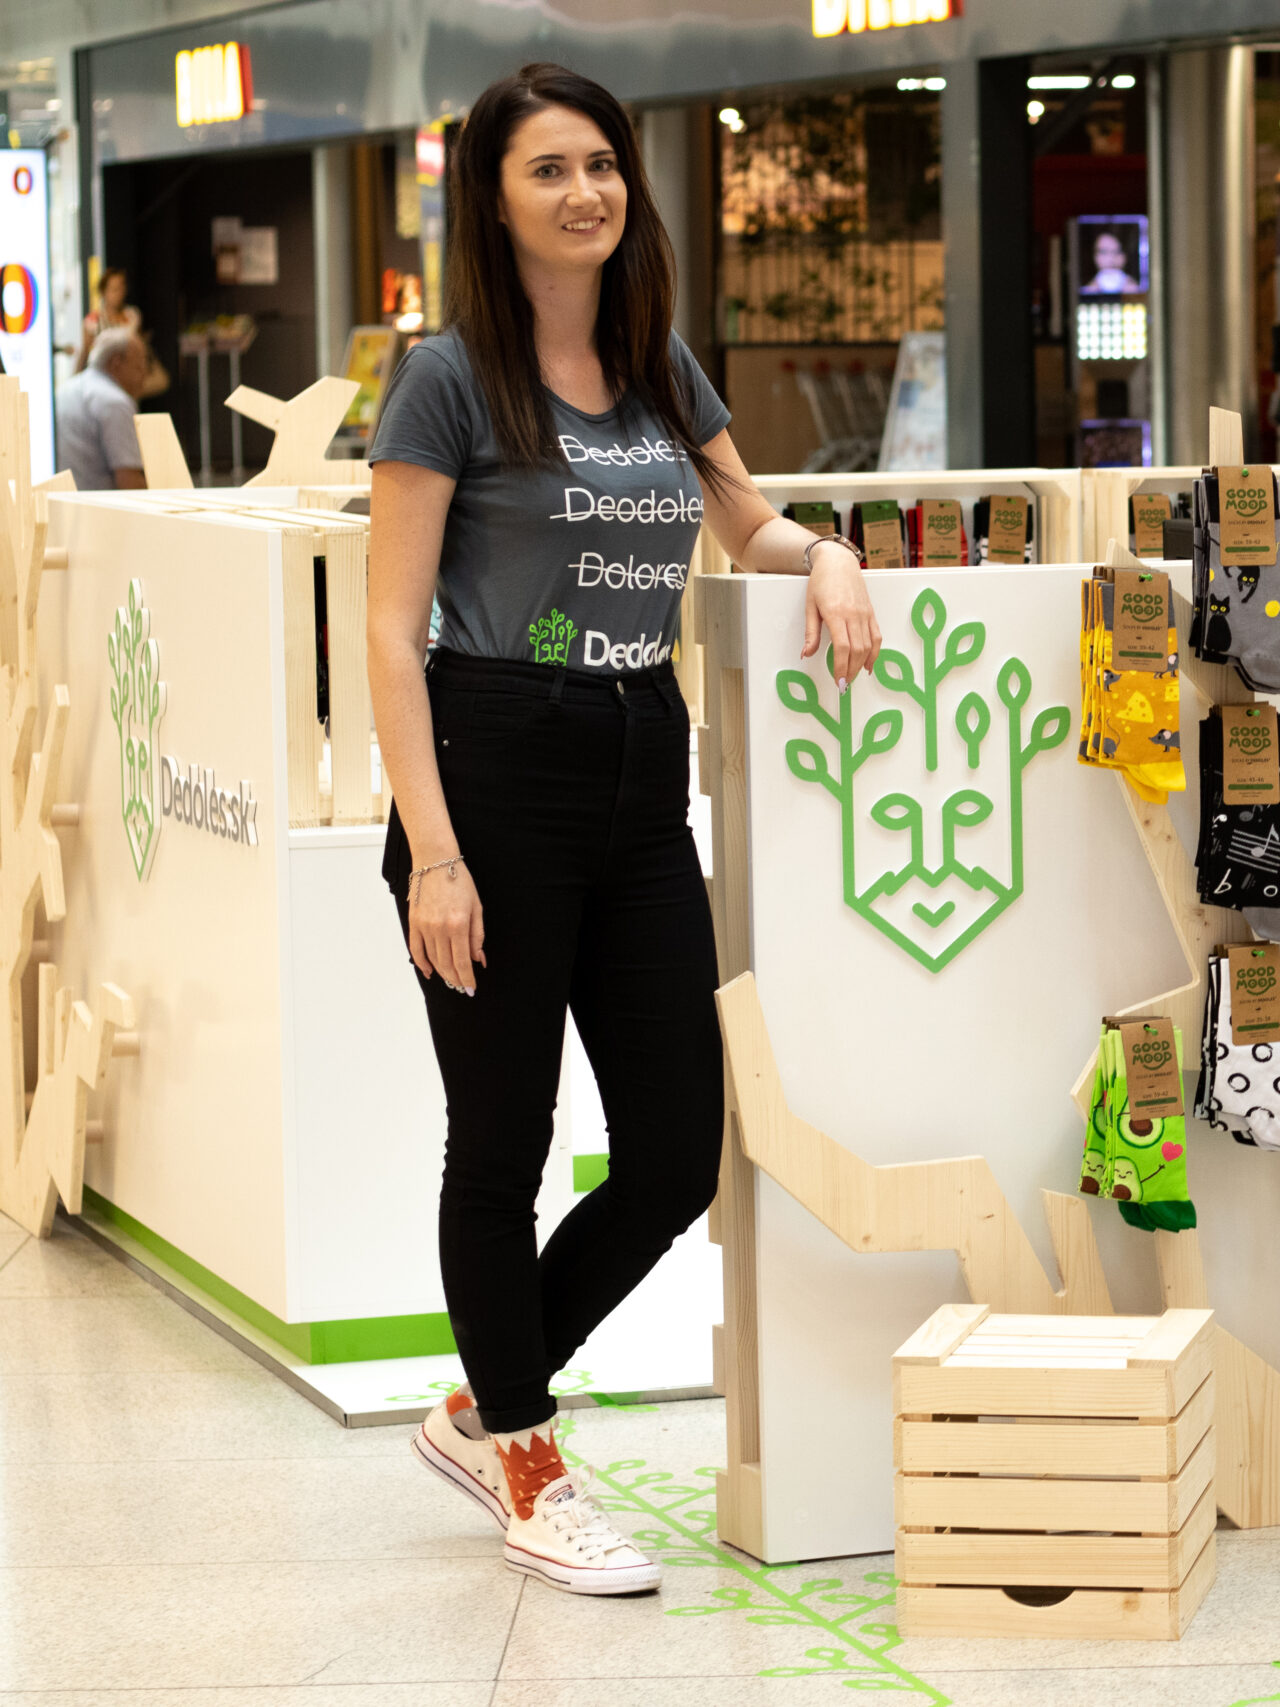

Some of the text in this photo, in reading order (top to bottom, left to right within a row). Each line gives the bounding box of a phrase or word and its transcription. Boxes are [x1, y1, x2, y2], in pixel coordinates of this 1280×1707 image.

[1226, 488, 1266, 499] GOOD
[1225, 499, 1268, 511] MOOD
[577, 552, 688, 590] Dolores
[1122, 593, 1164, 605] GOOD
[1121, 604, 1164, 617] MOOD
[1230, 726, 1270, 737] GOOD
[1229, 737, 1272, 749] MOOD
[161, 756, 252, 847] Dedoles.sk
[1236, 966, 1276, 979] GOOD
[1236, 977, 1277, 990] MOOD
[1132, 1040, 1170, 1054] GOOD
[1132, 1051, 1173, 1066] MOOD
